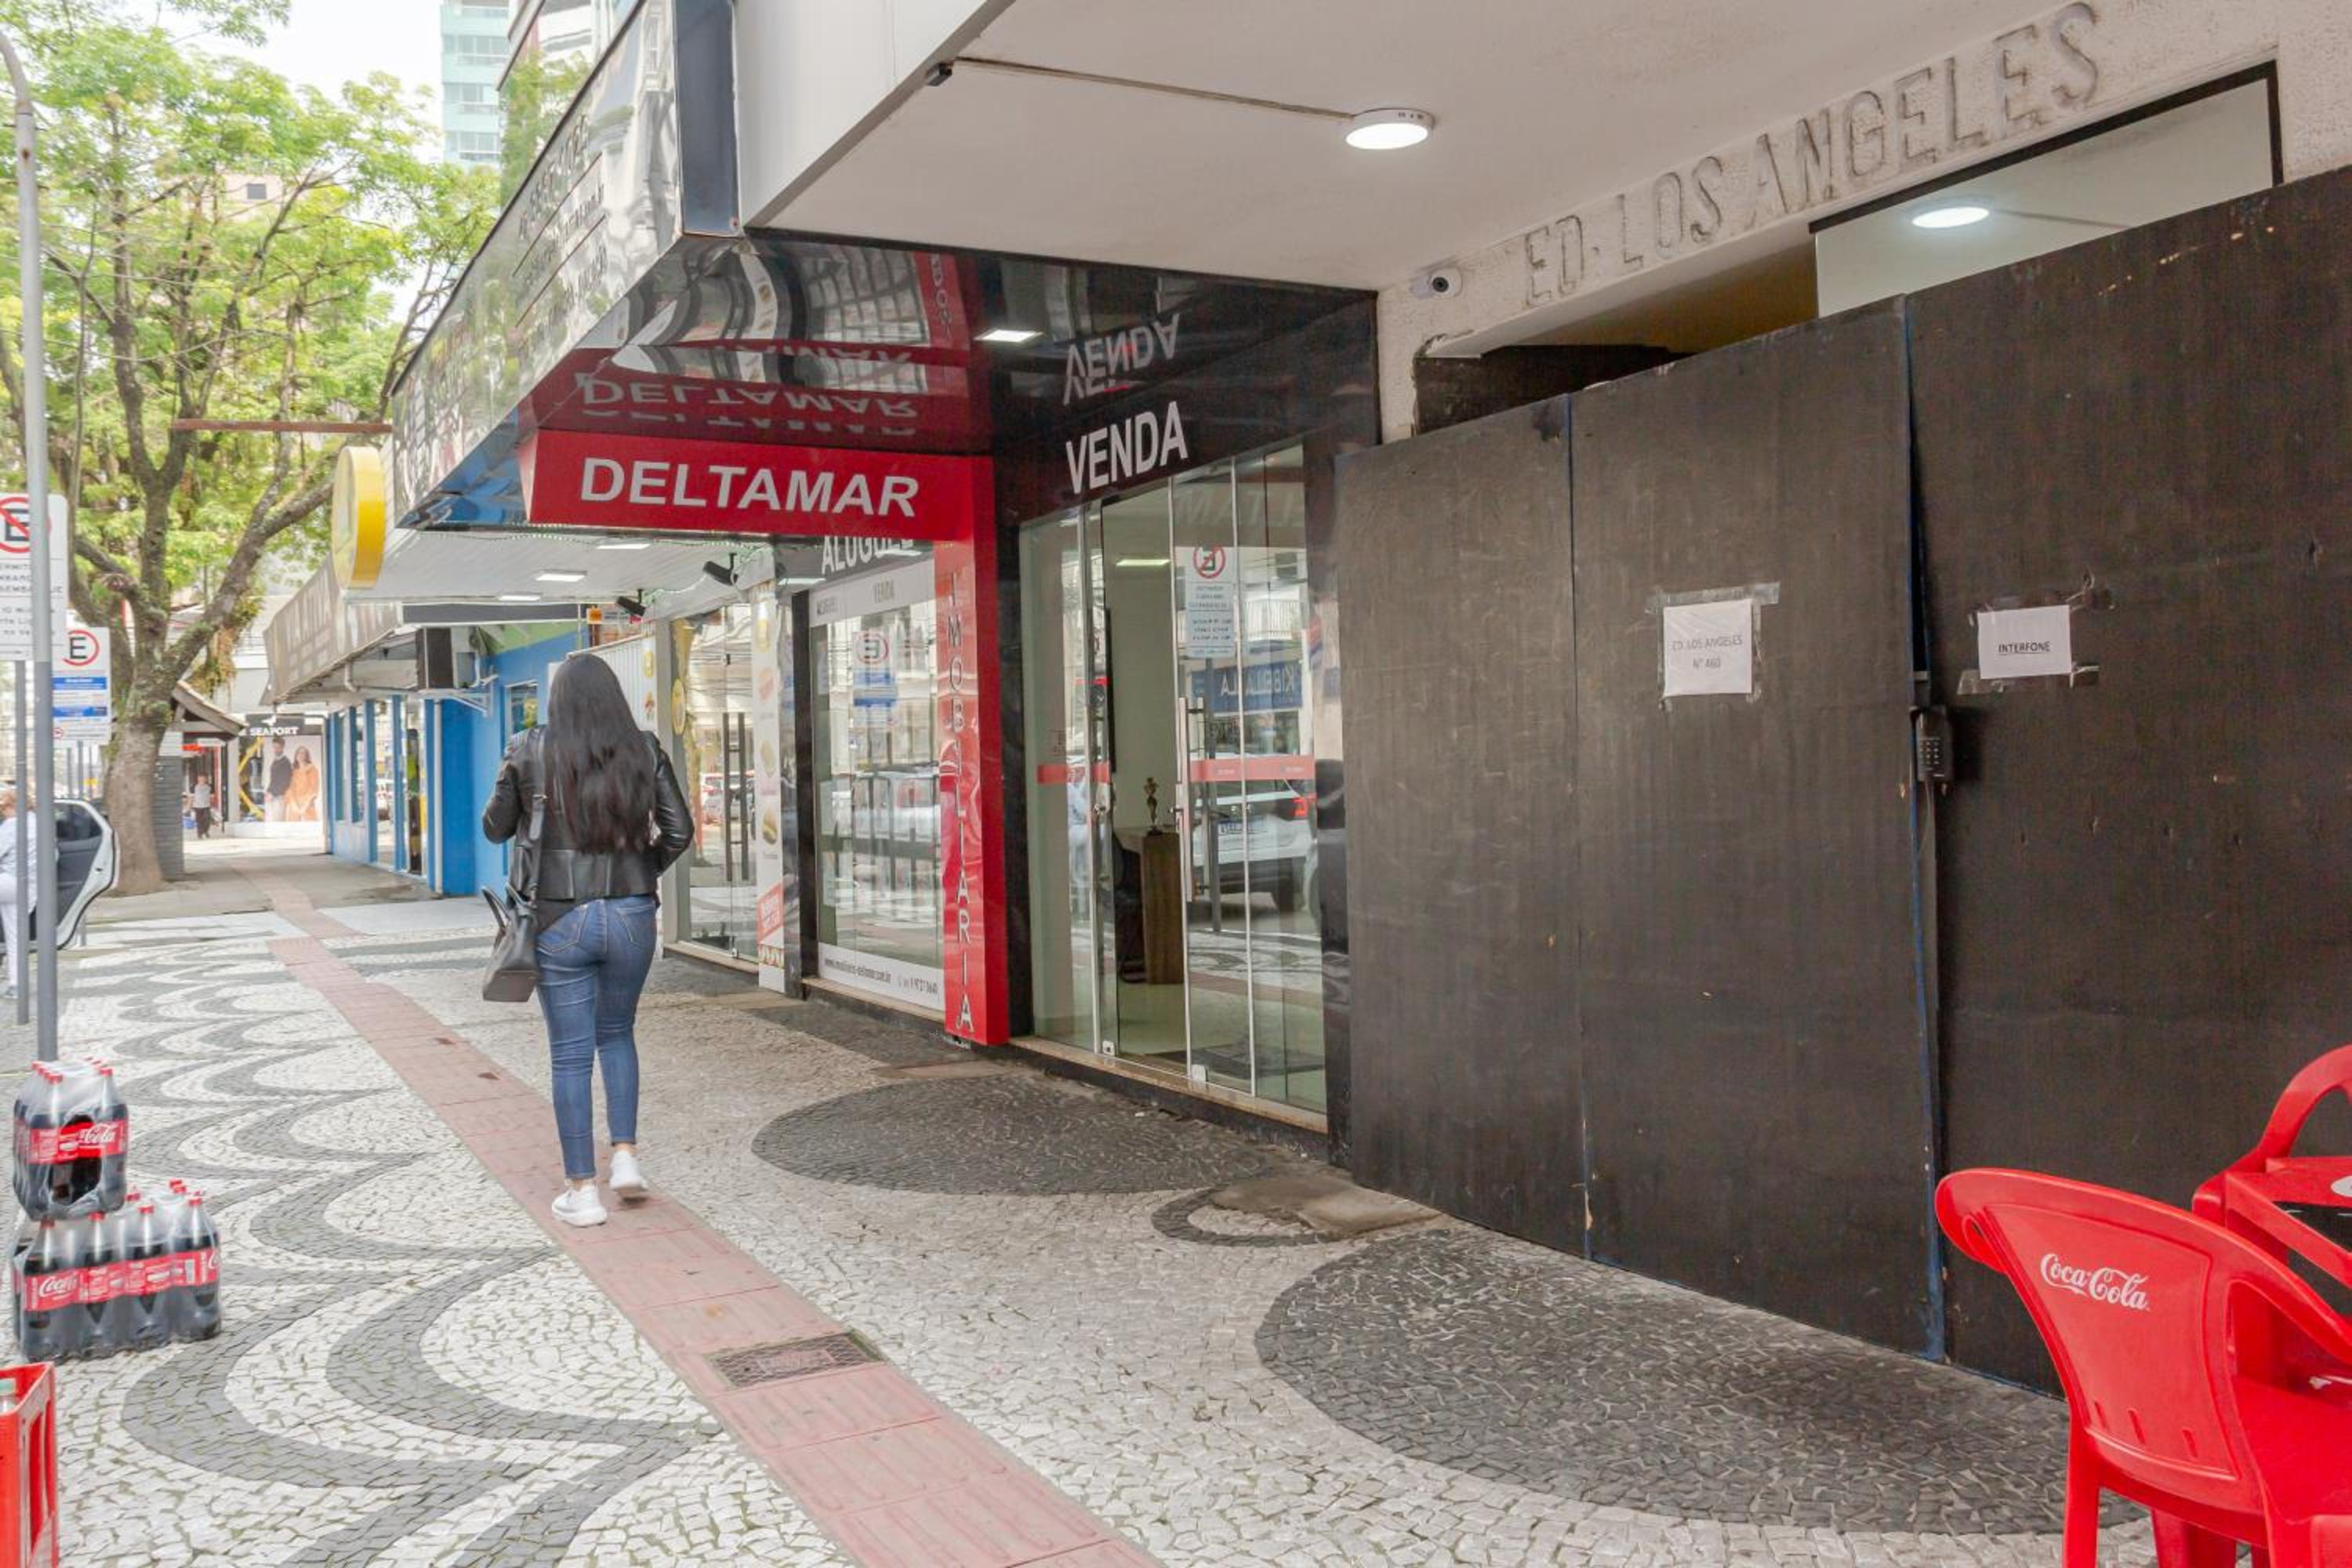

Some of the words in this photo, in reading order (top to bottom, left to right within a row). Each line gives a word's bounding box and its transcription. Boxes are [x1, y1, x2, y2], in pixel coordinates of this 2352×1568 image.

[1617, 155, 1726, 269] LOS
[1744, 2, 2101, 230] ANGELES
[1065, 401, 1188, 494] VENDA
[580, 458, 919, 517] DELTAMAR
[69, 637, 87, 659] E
[1998, 641, 2051, 653] INTERFONE
[250, 727, 299, 736] SEAPORT
[2040, 1253, 2151, 1312] Coca-Cola
